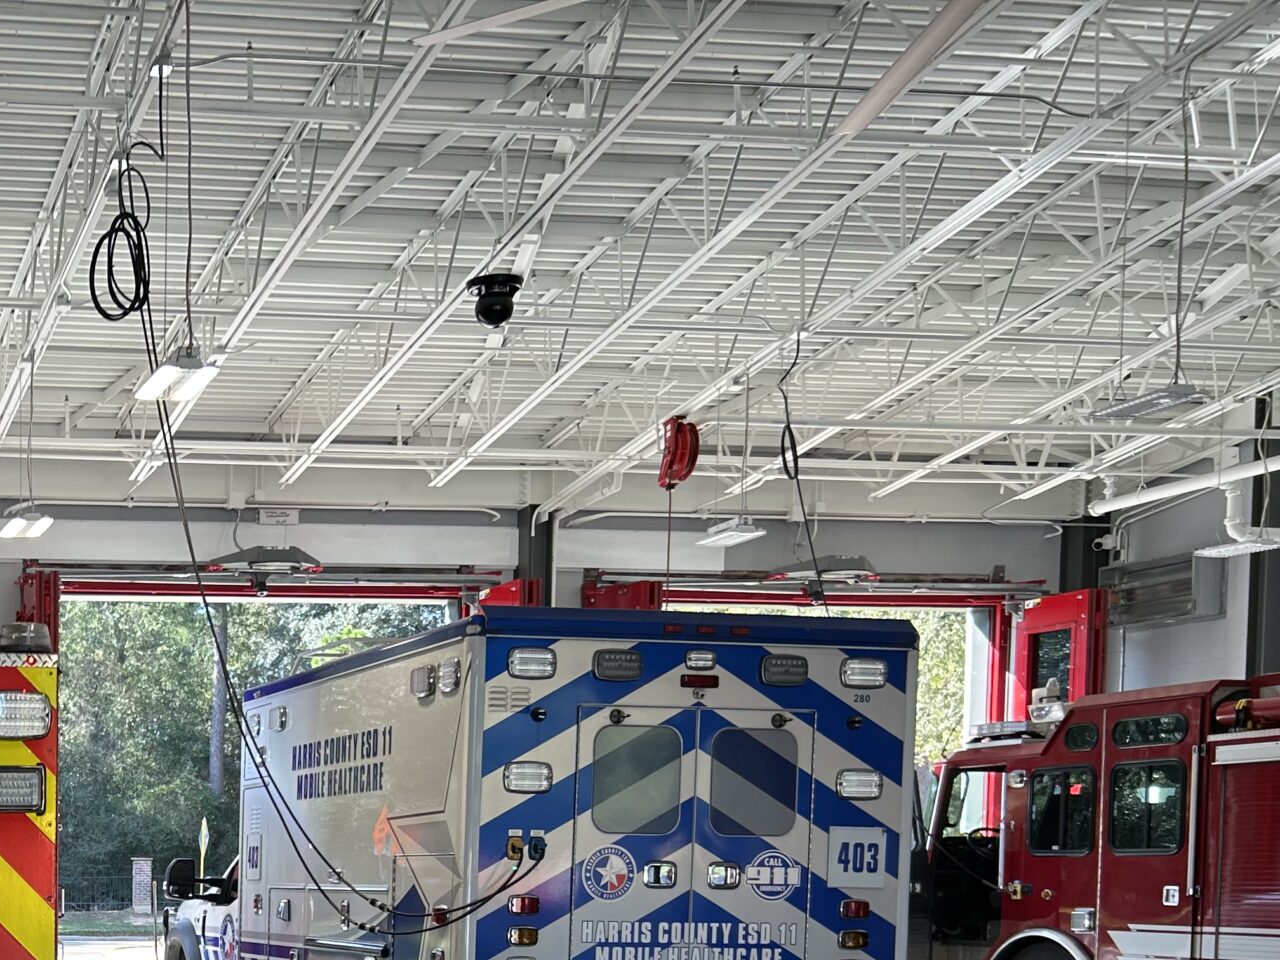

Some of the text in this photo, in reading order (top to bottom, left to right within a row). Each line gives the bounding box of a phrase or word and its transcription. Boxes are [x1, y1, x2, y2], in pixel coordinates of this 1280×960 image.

[853, 694, 870, 703] 280
[292, 725, 393, 771] HARRIS COUNTY ESD 11
[297, 762, 384, 801] MOBILE HEALTHCARE
[248, 845, 259, 870] 403
[764, 858, 783, 866] CALL
[837, 842, 879, 873] 403
[581, 920, 798, 946] HARRIS COUNTY ESD 11
